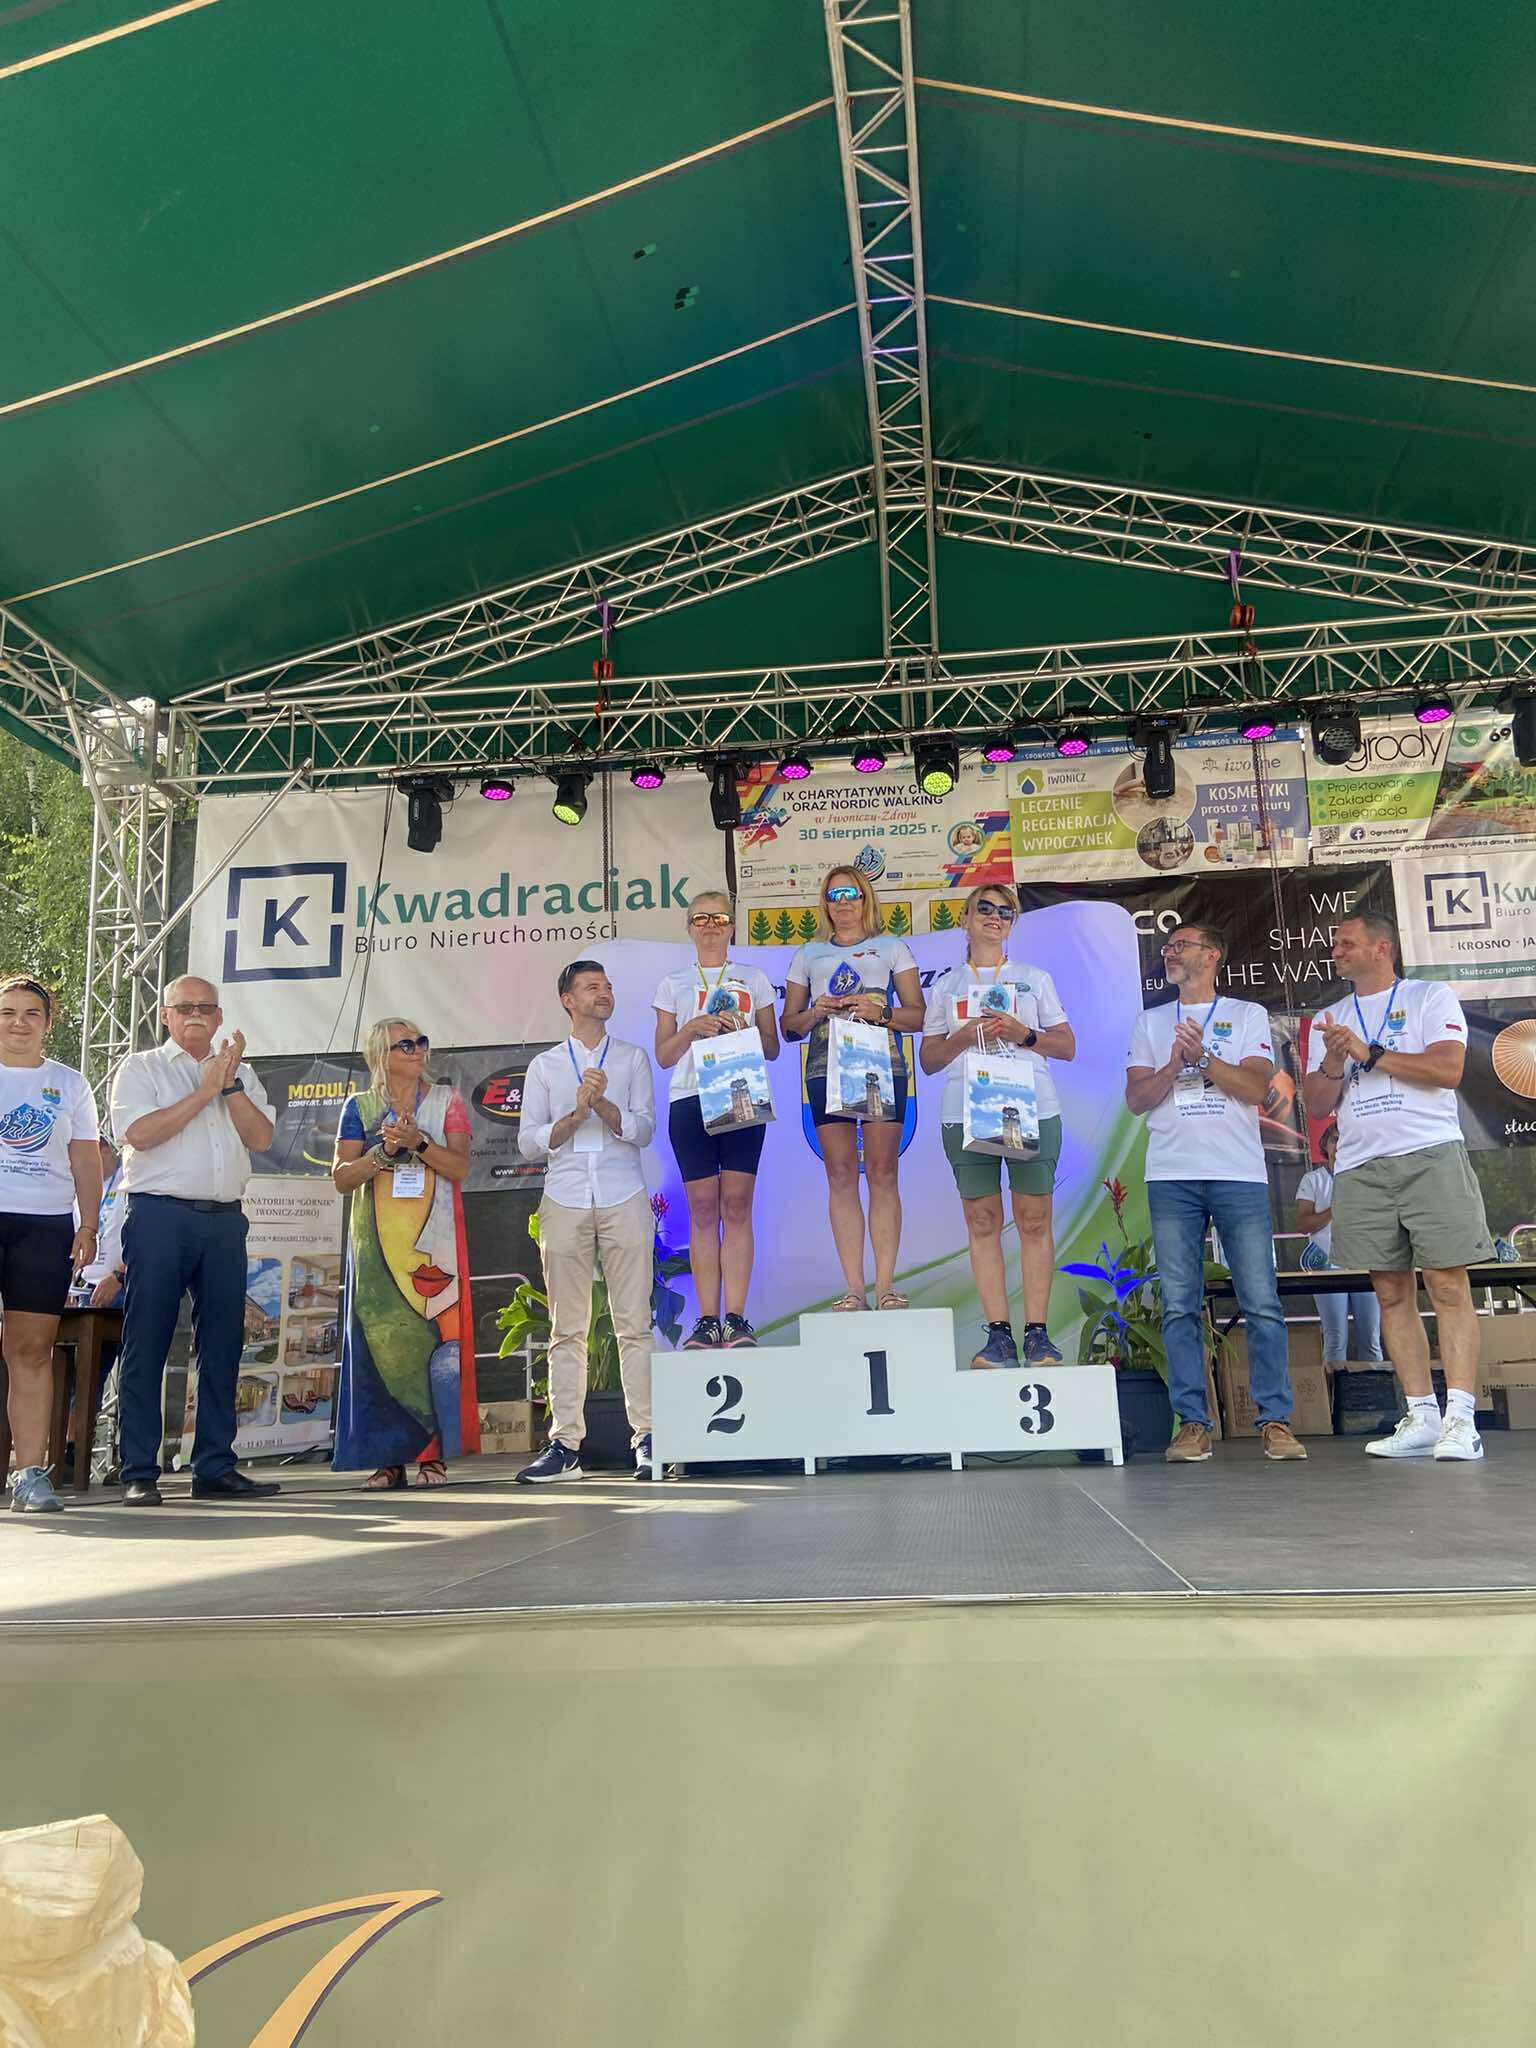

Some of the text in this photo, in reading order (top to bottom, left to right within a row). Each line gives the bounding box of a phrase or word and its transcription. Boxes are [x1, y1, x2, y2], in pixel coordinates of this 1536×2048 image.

[1489, 727, 1511, 742] 69
[1344, 725, 1445, 772] grody
[1224, 758, 1281, 772] iwone
[1048, 773, 1087, 784] IWONICZ
[1327, 779, 1416, 793] Projektowanie
[783, 791, 794, 801] IX
[798, 785, 905, 801] CHARYTATYWNY
[1209, 783, 1289, 801] KOSMETYKI
[1329, 792, 1402, 807] Zakładanie
[792, 795, 943, 812] ORAZ NORDIC WALKING
[1021, 797, 1083, 813] LECZENIE
[1201, 804, 1238, 817] prosto
[1251, 800, 1291, 812] ntury
[815, 810, 918, 825] w Iwoniczu-Zdroju
[1022, 813, 1117, 833] REGENERACJA
[799, 823, 941, 840] 30 sierpnia 2025 r.
[1023, 832, 1113, 852] WYPOCZYNEK
[356, 863, 690, 928] Kwadraciak
[1310, 891, 1357, 914] WE
[1445, 888, 1473, 915] K
[1495, 907, 1531, 917] Biuro
[262, 895, 309, 948] K
[354, 920, 618, 954] Biuro Nieruchomości
[1457, 938, 1511, 951] KROSNO
[1273, 959, 1346, 983] WAT
[1459, 967, 1504, 977] Skuteczna
[287, 1080, 357, 1100] MODULO
[255, 1207, 320, 1218] IWONICZ-ZDRÓJ
[863, 1350, 895, 1416] 1
[705, 1375, 746, 1435] 2
[1019, 1383, 1055, 1435] 3
